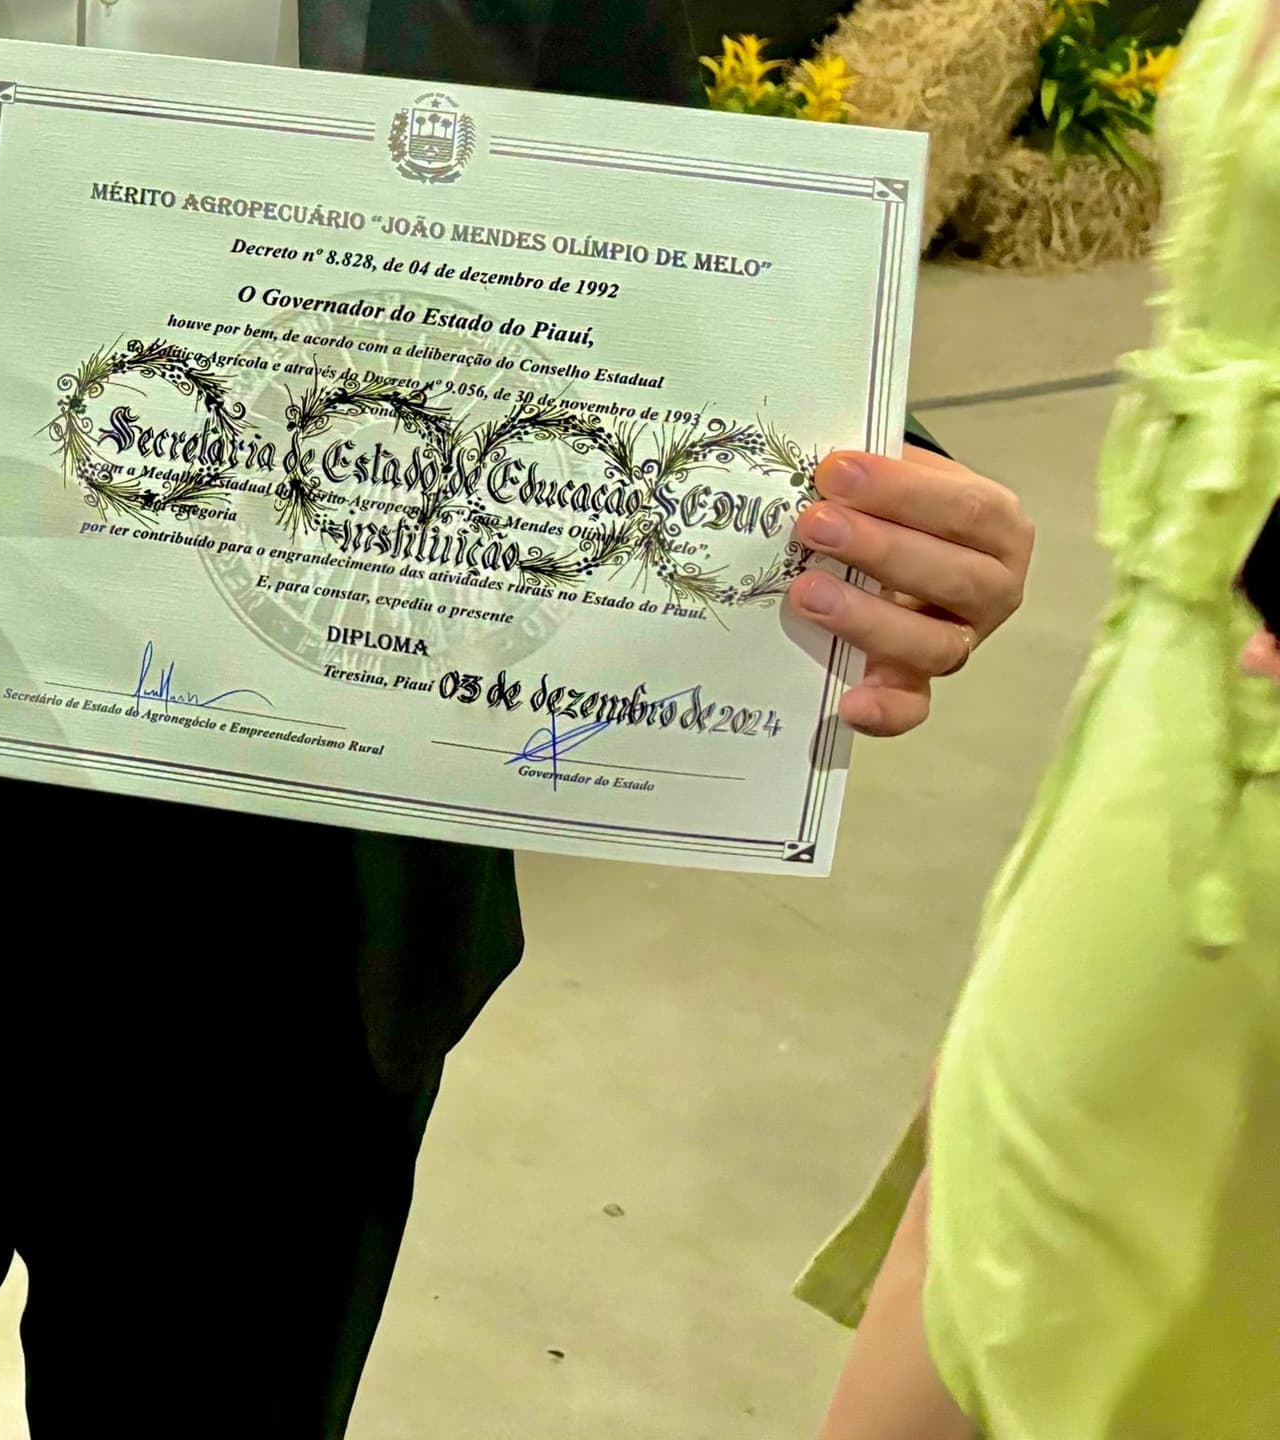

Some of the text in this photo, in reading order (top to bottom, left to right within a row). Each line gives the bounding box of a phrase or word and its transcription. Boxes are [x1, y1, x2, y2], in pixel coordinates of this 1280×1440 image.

[90, 180, 772, 277] MÉRITO AGROPECUÁRIO “JOÃO MENDES OLÍMPIO DE MELO”
[229, 237, 620, 299] Decreto nº 8.828, de 04 de dezembro de 1992
[166, 313, 665, 389] houve por bem, de acordo com a deliberação do Conselho Estadual
[237, 284, 594, 349] O Governador do Estado do Piauí,
[97, 406, 277, 472] Secretaria
[283, 429, 316, 475] de
[321, 438, 439, 495] Estado
[79, 521, 713, 620] por ter contribuído para o engrandecimento das atividades rurais no Estado do Piauí.
[255, 574, 514, 624] E, para constar, expediu o presente
[325, 624, 431, 656] DIPLOMA
[323, 663, 782, 736] Teresina, Piauí 03 de dezembro de 2024
[517, 765, 654, 791] Governador do Estado
